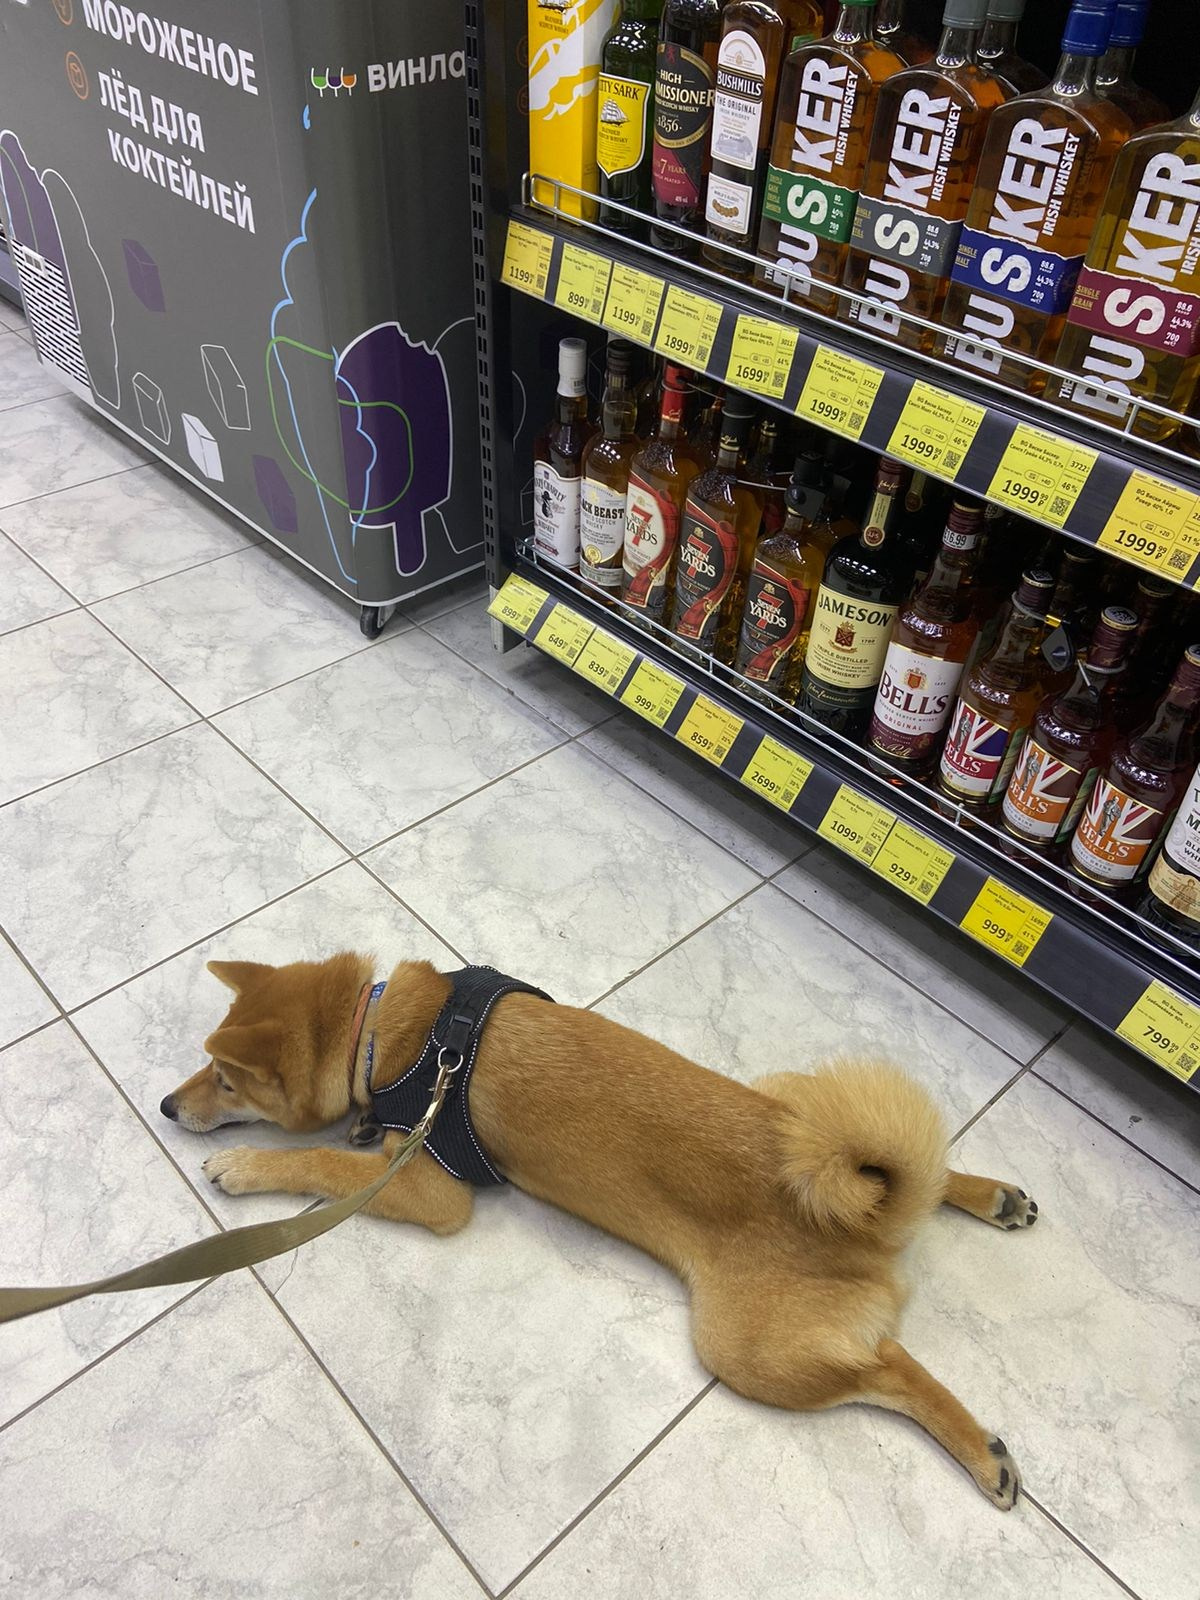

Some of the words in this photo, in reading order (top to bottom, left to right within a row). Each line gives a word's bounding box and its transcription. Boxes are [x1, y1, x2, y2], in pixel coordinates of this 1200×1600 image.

[82, 0, 258, 95] МОРОЖЕНОЕ
[660, 69, 682, 85] HIGH
[717, 70, 764, 97] BUSHMILLS
[613, 83, 640, 101] SARK
[840, 70, 859, 129] WHISKEY
[98, 69, 149, 133] ЛЁД
[149, 95, 205, 152] ДЛЯ
[678, 105, 700, 113] WHISKY
[717, 95, 726, 108] THE
[726, 99, 757, 116] ORIGINAL
[937, 101, 961, 163] WHISKEY
[834, 133, 849, 166] IRISH
[660, 158, 668, 175] 7
[773, 57, 849, 296] BUSKER
[107, 129, 256, 234] КОКТЕЙЛЕЙ
[930, 166, 947, 202] IRISH
[1042, 199, 1062, 236] IRISH
[1052, 132, 1081, 198] WHISKEY
[857, 88, 951, 337] BUSKER
[944, 335, 957, 357] THE
[953, 117, 1068, 375] BUSKER
[957, 244, 979, 258] SINGLE
[1179, 235, 1200, 275] IRISH
[508, 265, 530, 282] 1199
[1040, 260, 1055, 271] 88.6
[1036, 275, 1055, 287] 44.3%
[1059, 377, 1075, 400] THE
[1070, 152, 1200, 419] BUSKER
[566, 291, 586, 307] 899
[1032, 290, 1045, 300] 700
[1075, 284, 1102, 300] SINGLE
[611, 305, 636, 324] 1199
[1176, 301, 1193, 312] 88.6
[1171, 316, 1193, 330] 44.3%
[663, 334, 690, 354] 1899
[1165, 332, 1181, 342] 700
[735, 362, 764, 384] 1699
[809, 398, 840, 421] 1999
[900, 433, 935, 458] 1999
[952, 435, 968, 447] 46%
[1028, 443, 1043, 453] Виски
[1001, 477, 1040, 505] 1999
[1039, 492, 1049, 501] 99
[1040, 477, 1051, 486] +40
[1061, 481, 1079, 495] 46%
[1134, 495, 1152, 507] Ровер
[1151, 502, 1164, 511] 40%
[1144, 491, 1162, 503] Виски
[1161, 498, 1181, 511] Айриш
[594, 505, 625, 519] BEAST
[625, 516, 658, 546] YARDS
[1158, 528, 1170, 537] +20
[1114, 527, 1157, 558] 1999
[1156, 544, 1167, 554] 99
[680, 544, 716, 578] YARDS
[500, 605, 518, 619] 899
[749, 600, 788, 629] YARDS
[757, 598, 782, 616] SEVEN
[818, 593, 891, 627] JAMESON
[547, 633, 564, 648] 649
[817, 644, 835, 658] TRIPLE
[835, 653, 869, 664] DISTILLED
[587, 660, 606, 676] 839
[831, 668, 861, 679] WHISKEY
[633, 693, 653, 710] 999
[879, 670, 950, 716] BELL'S
[884, 713, 923, 731] ORIGINAL
[689, 730, 710, 748] 859
[945, 739, 982, 773] BELL'S
[750, 770, 777, 792] 2699
[1009, 775, 1049, 814] BELL'S
[829, 819, 858, 842] 1099
[1080, 814, 1130, 858] BELL'S
[887, 861, 912, 882] 929
[980, 918, 1007, 939] 999
[1141, 1024, 1171, 1050] 799
[1169, 1042, 1179, 1051] 99
